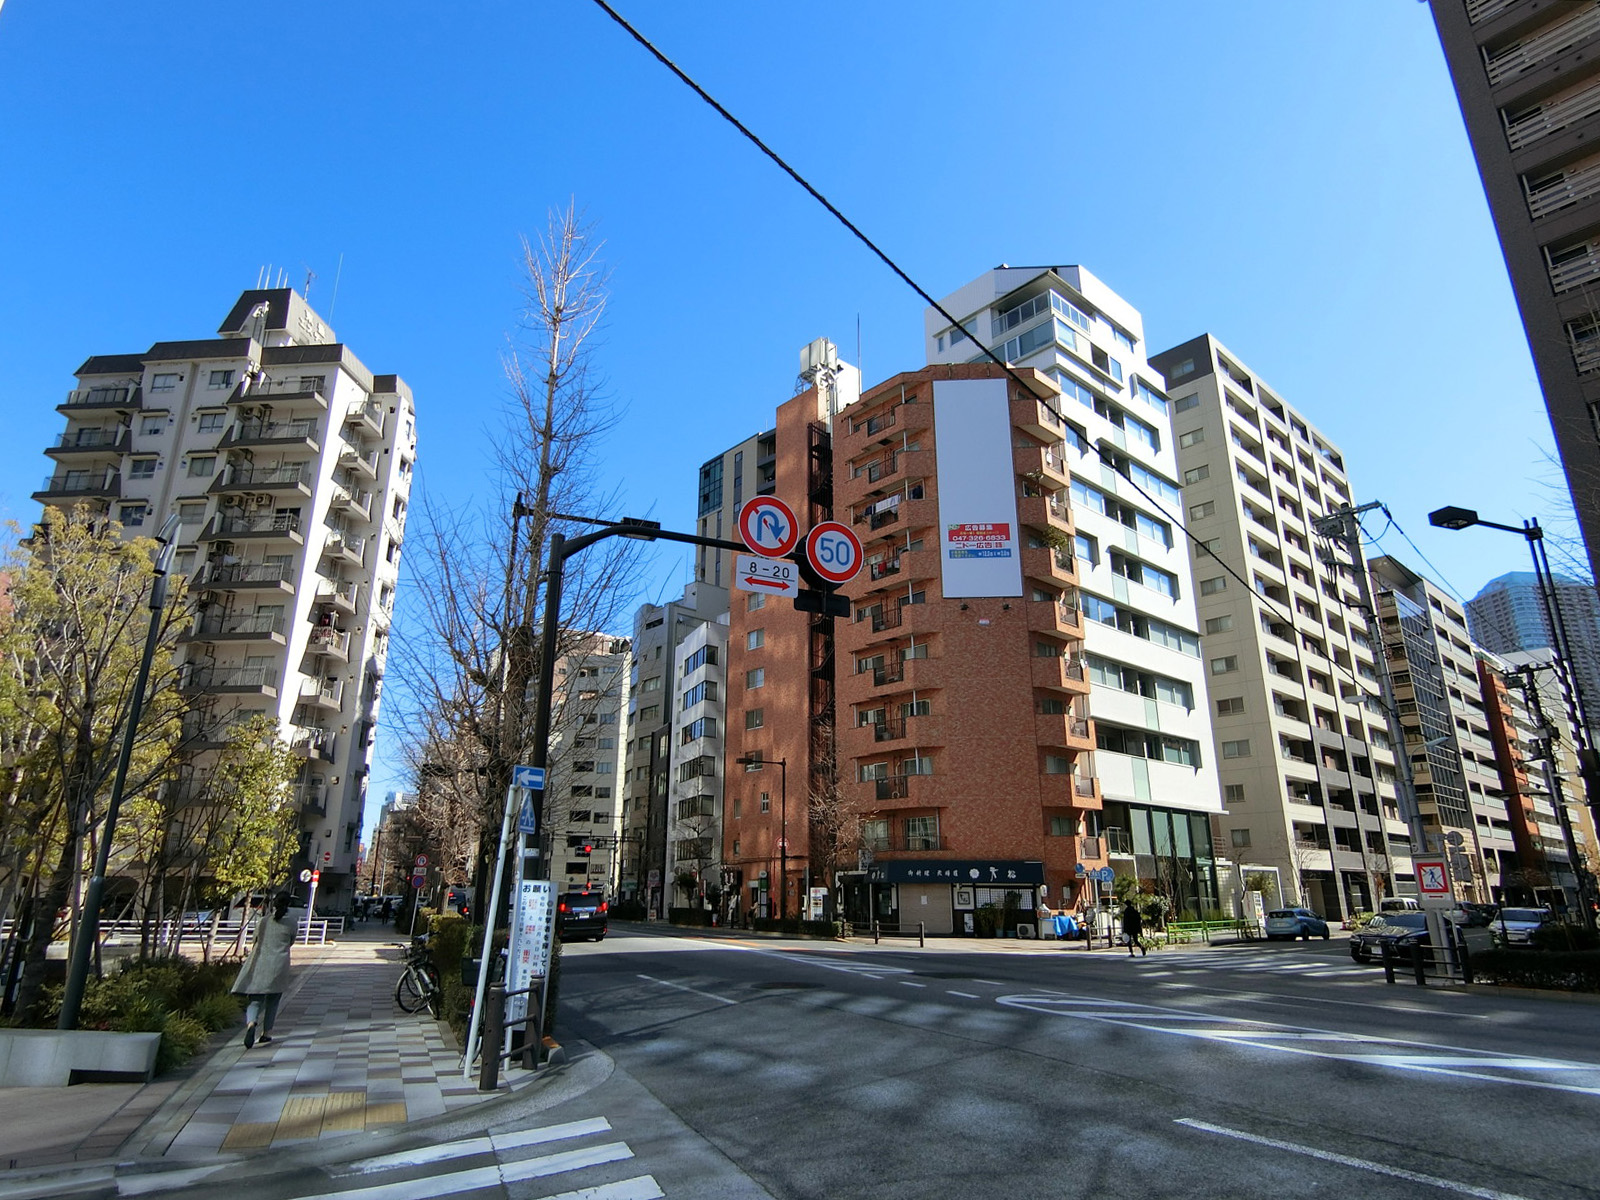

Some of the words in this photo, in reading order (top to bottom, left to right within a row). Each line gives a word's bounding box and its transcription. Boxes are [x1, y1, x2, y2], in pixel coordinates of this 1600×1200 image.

[820, 537, 850, 566] 50
[522, 884, 551, 893] お願い
